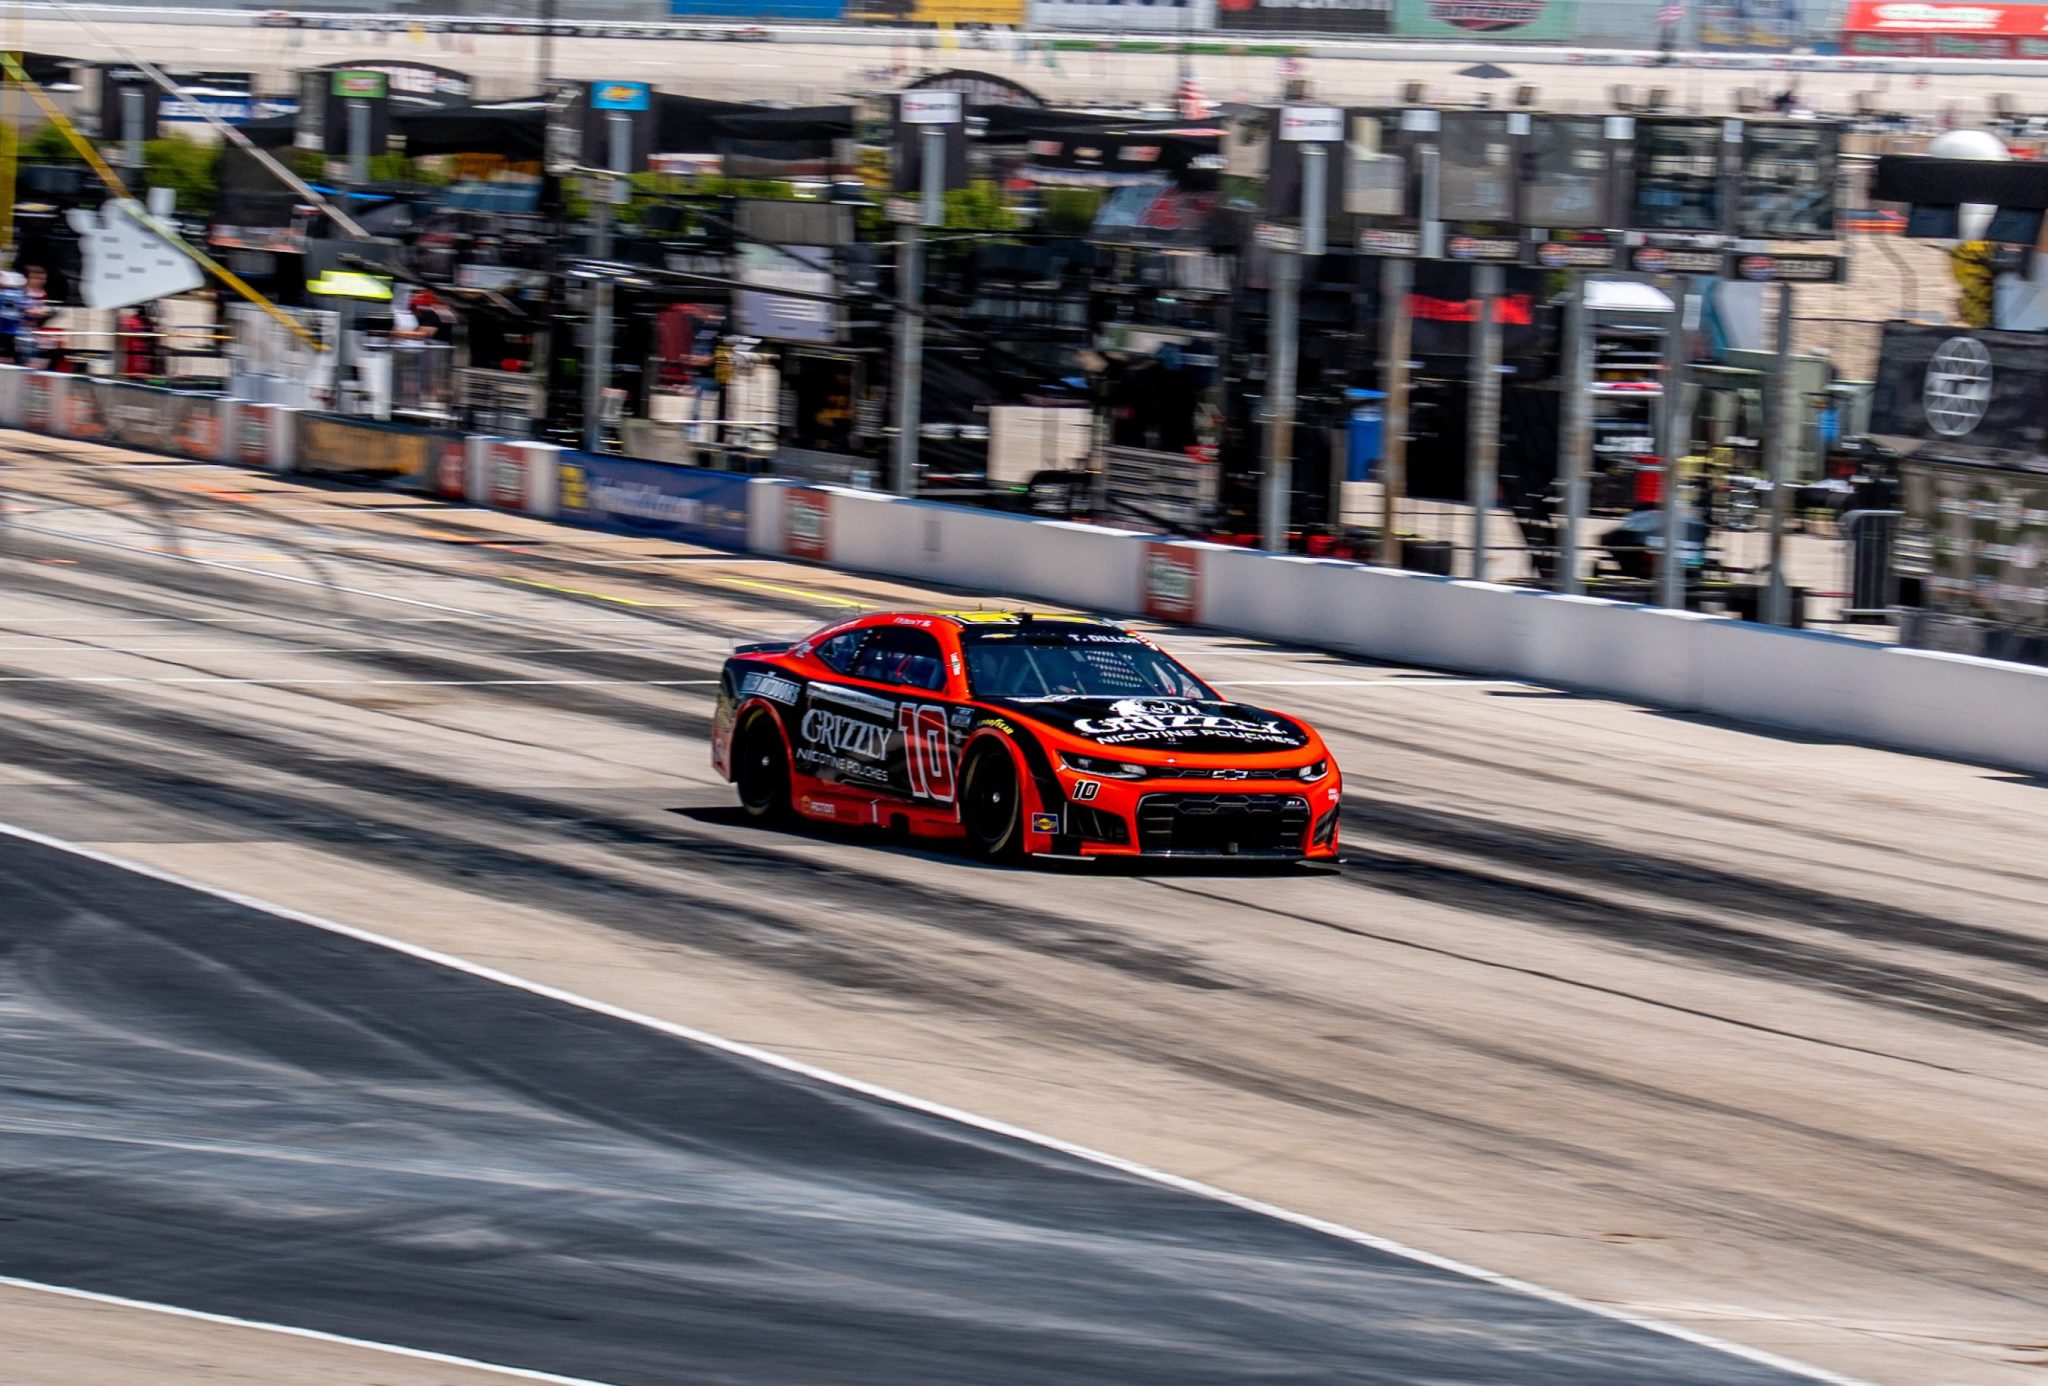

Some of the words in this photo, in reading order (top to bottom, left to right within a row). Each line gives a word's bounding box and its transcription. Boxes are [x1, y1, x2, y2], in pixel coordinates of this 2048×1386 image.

[801, 708, 893, 761] GRIZZLY
[1073, 714, 1288, 735] GRIZZLY
[1097, 729, 1198, 744] NICOTINE
[1202, 729, 1301, 746] POUCHES
[796, 748, 846, 770] NICOTINE
[846, 760, 889, 782] POUCHES
[898, 702, 955, 802] 10
[1072, 779, 1101, 801] 10
